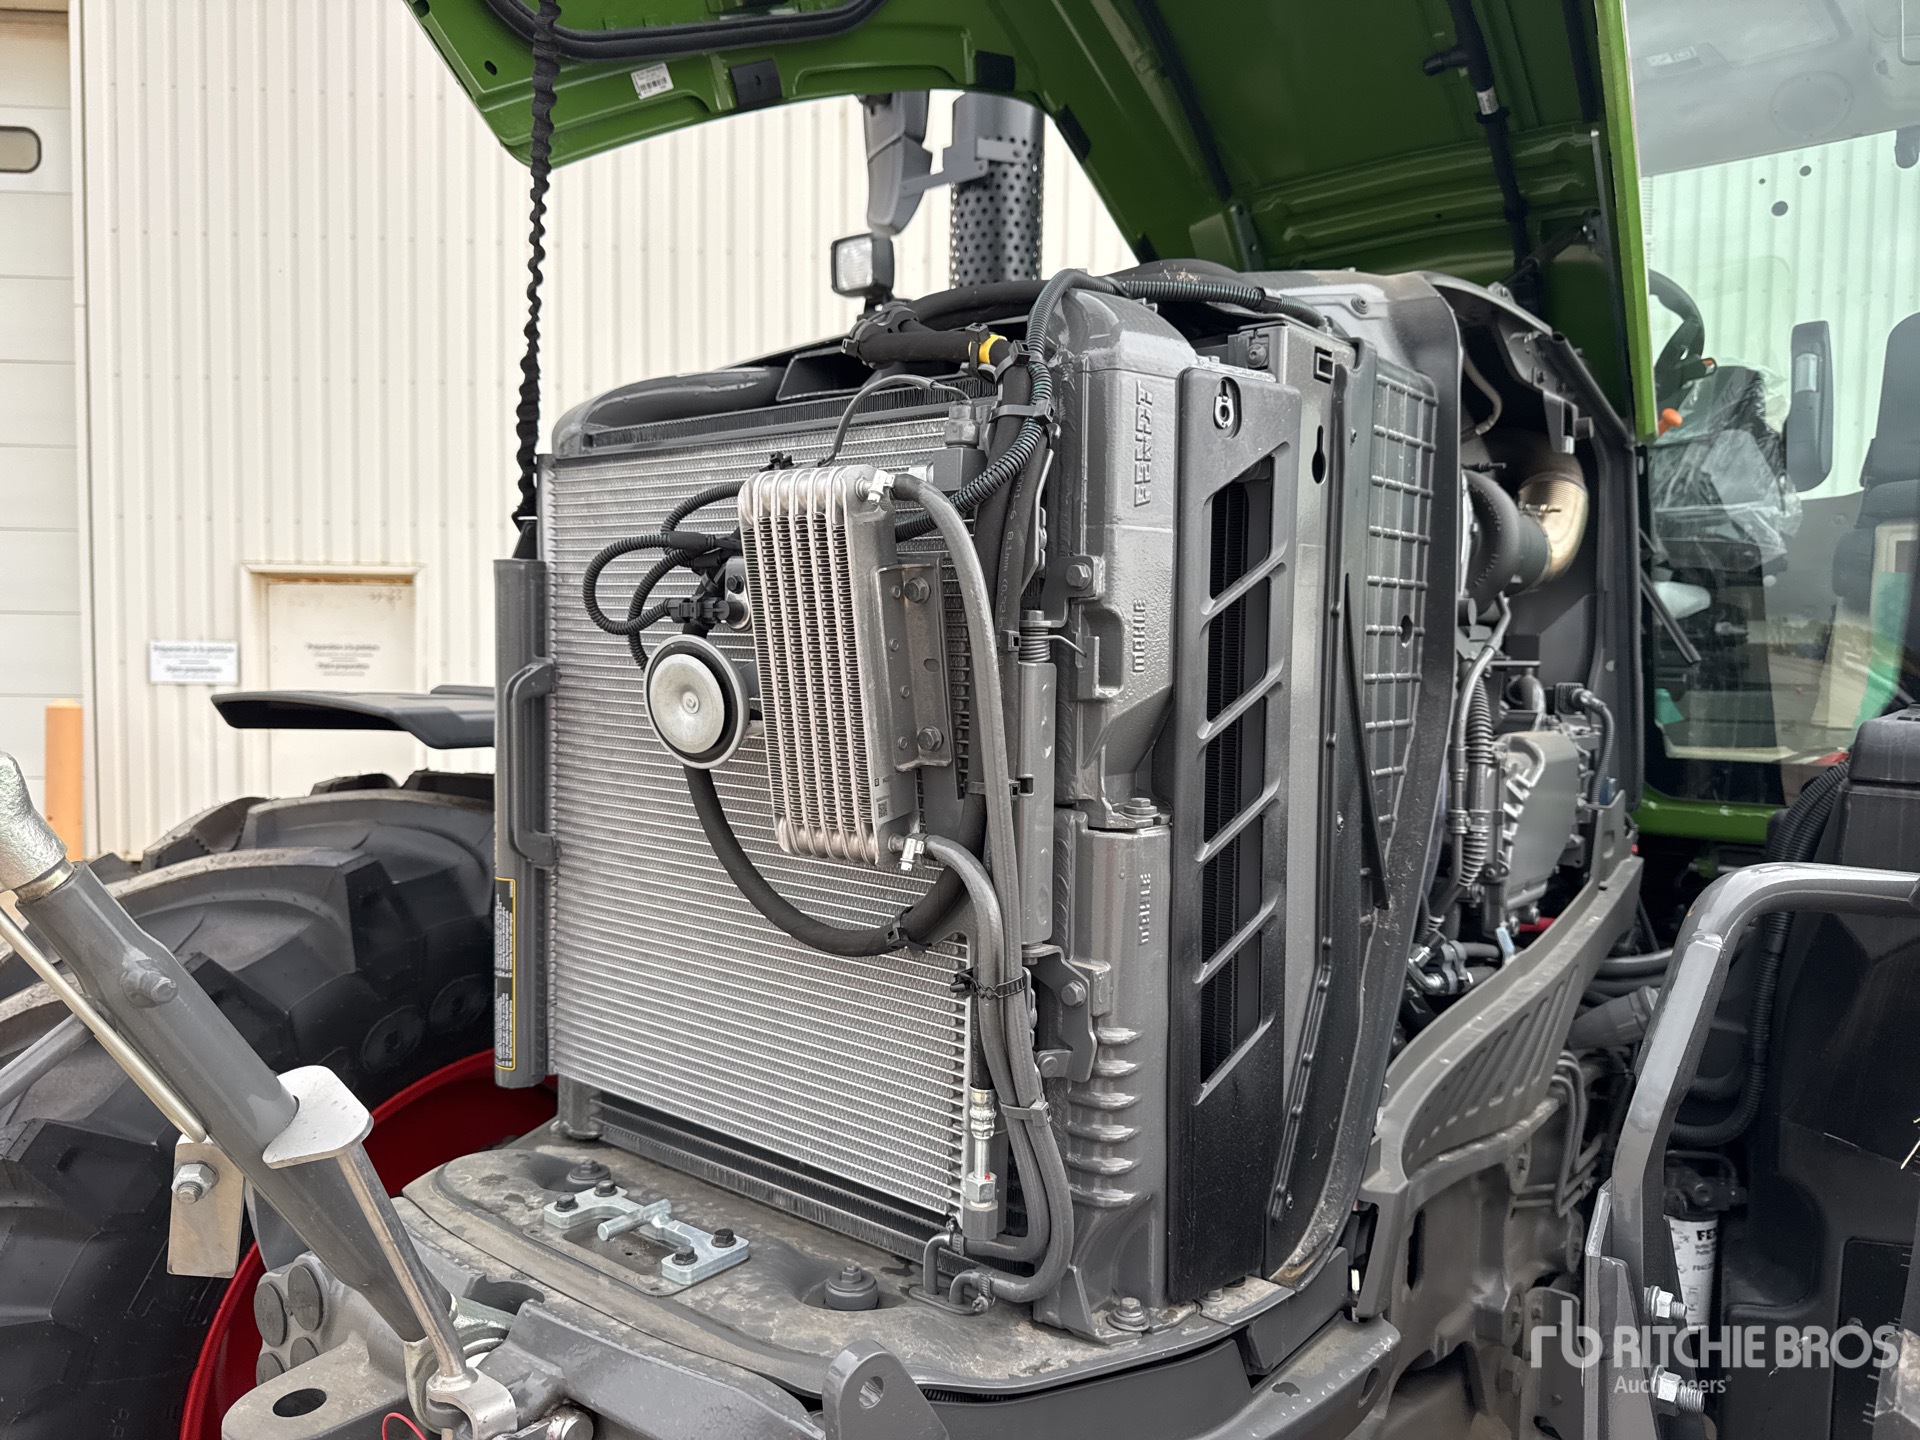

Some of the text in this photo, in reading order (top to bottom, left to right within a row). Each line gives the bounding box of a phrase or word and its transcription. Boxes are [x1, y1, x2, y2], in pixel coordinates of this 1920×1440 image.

[1134, 379, 1153, 508] FENDT
[1132, 599, 1146, 673] MAHLE
[1138, 873, 1151, 946] MAHLE
